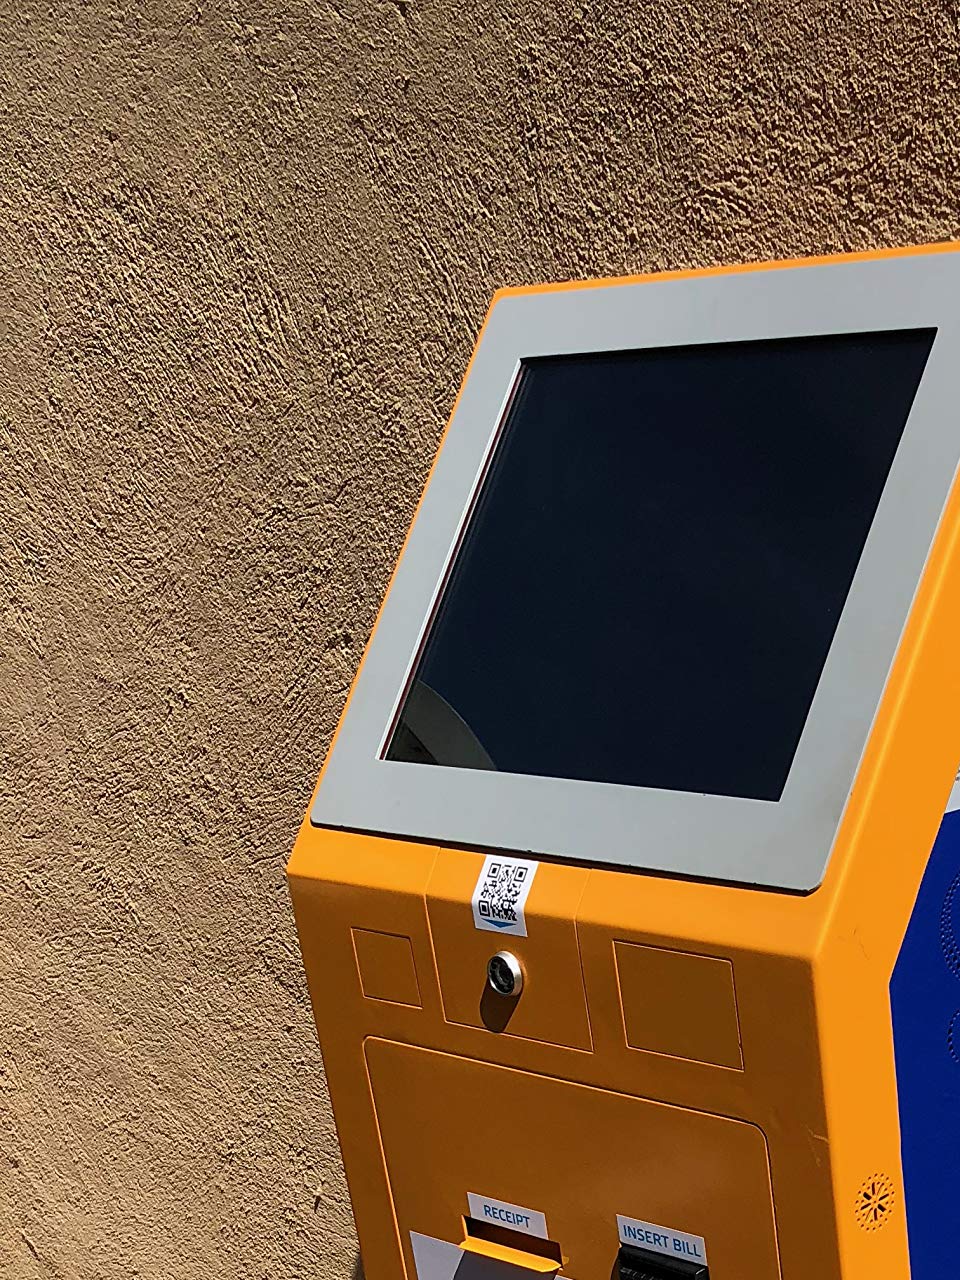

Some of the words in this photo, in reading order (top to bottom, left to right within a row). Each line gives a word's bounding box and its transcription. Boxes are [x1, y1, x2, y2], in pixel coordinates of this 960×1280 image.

[483, 1204, 531, 1228] RECEIPT
[623, 1224, 669, 1249] INSERT
[672, 1237, 702, 1258] BILL
